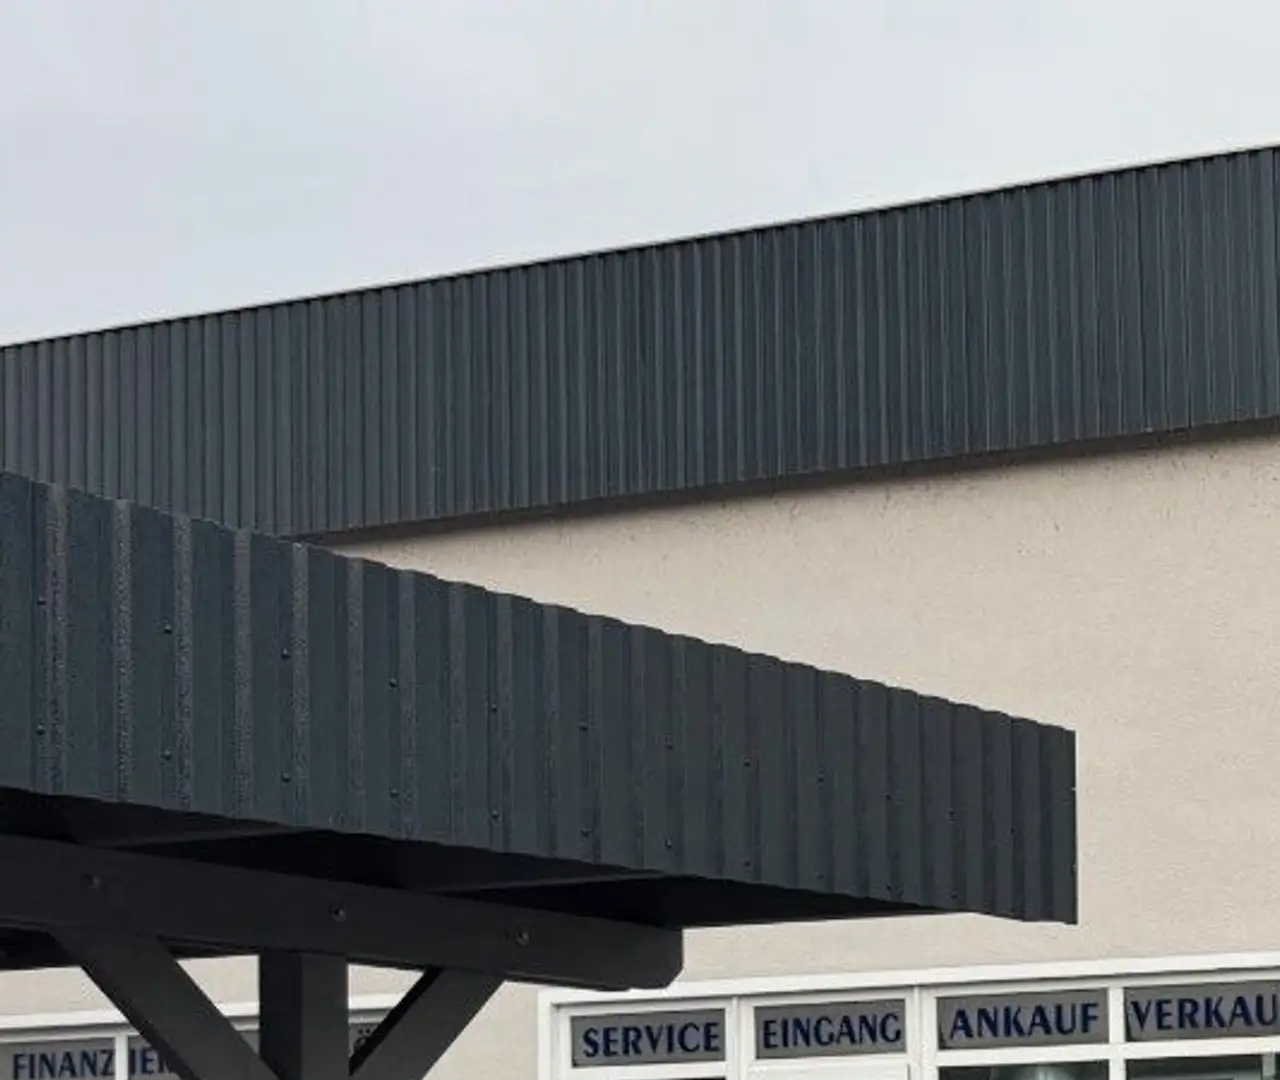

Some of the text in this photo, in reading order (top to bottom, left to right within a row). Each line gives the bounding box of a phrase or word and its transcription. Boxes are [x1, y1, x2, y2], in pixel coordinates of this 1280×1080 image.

[582, 1021, 721, 1058] SERVICE
[763, 1013, 901, 1049] EINGANG
[950, 1002, 1099, 1040] ANKAUF
